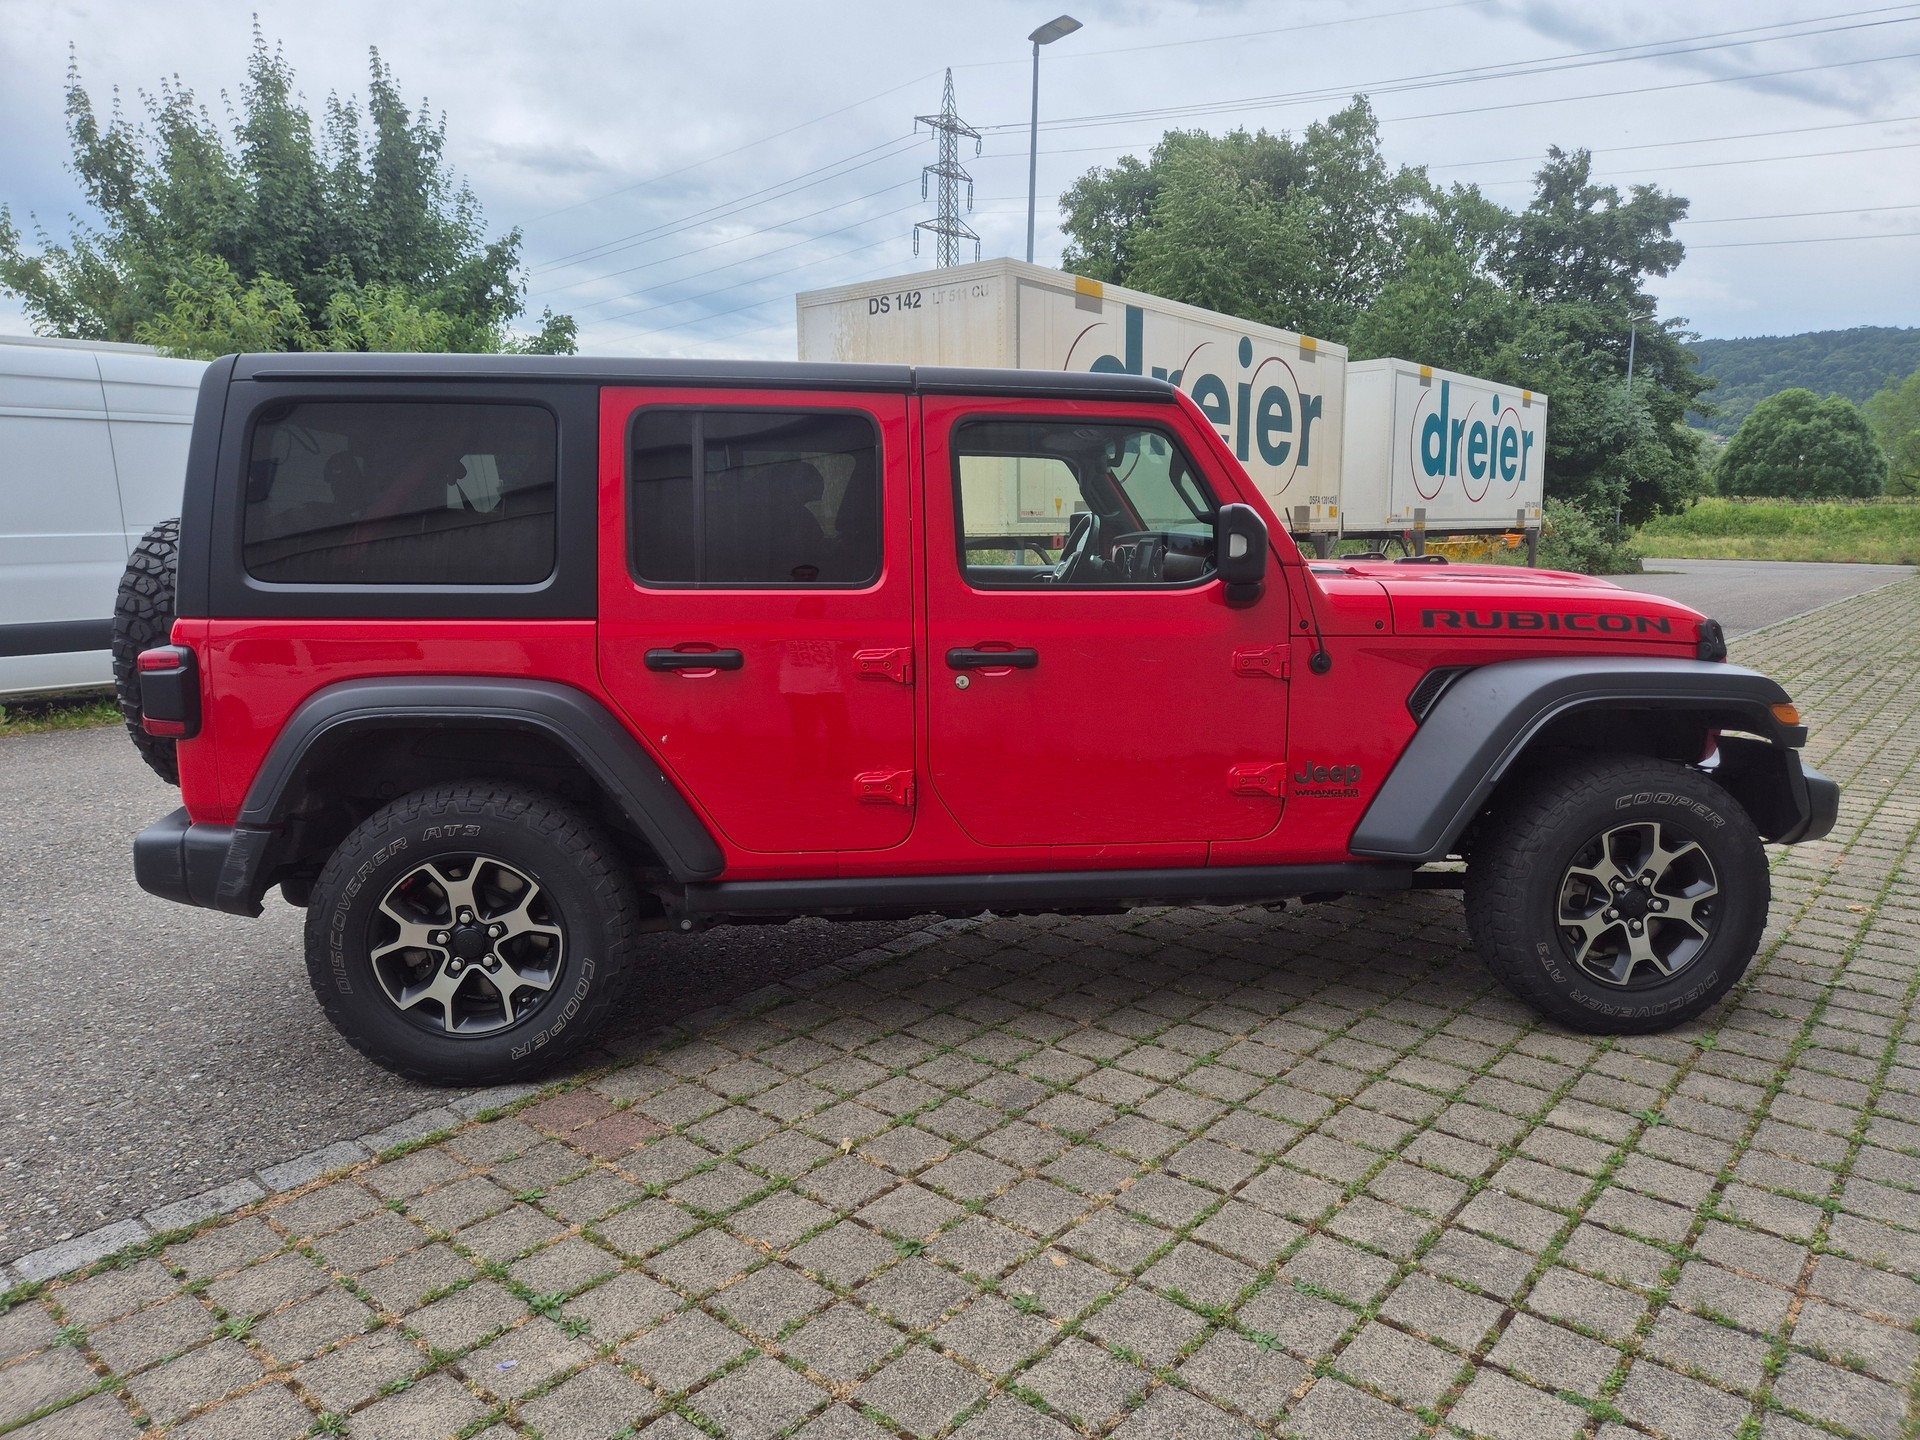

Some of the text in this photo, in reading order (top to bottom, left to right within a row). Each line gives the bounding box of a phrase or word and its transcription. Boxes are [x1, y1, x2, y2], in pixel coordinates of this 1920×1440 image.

[869, 291, 922, 315] DS 142
[972, 283, 989, 298] CU
[1421, 380, 1534, 482] dreier
[1421, 609, 1672, 634] RUBICON
[1295, 761, 1362, 786] Jeep
[1295, 788, 1359, 797] WRANGLER
[1614, 791, 1726, 829] COOPER
[328, 823, 482, 995] DISCOVERER AT3
[1535, 942, 1720, 1019] DISCOVERER AT3
[510, 957, 597, 1061] COOPER
